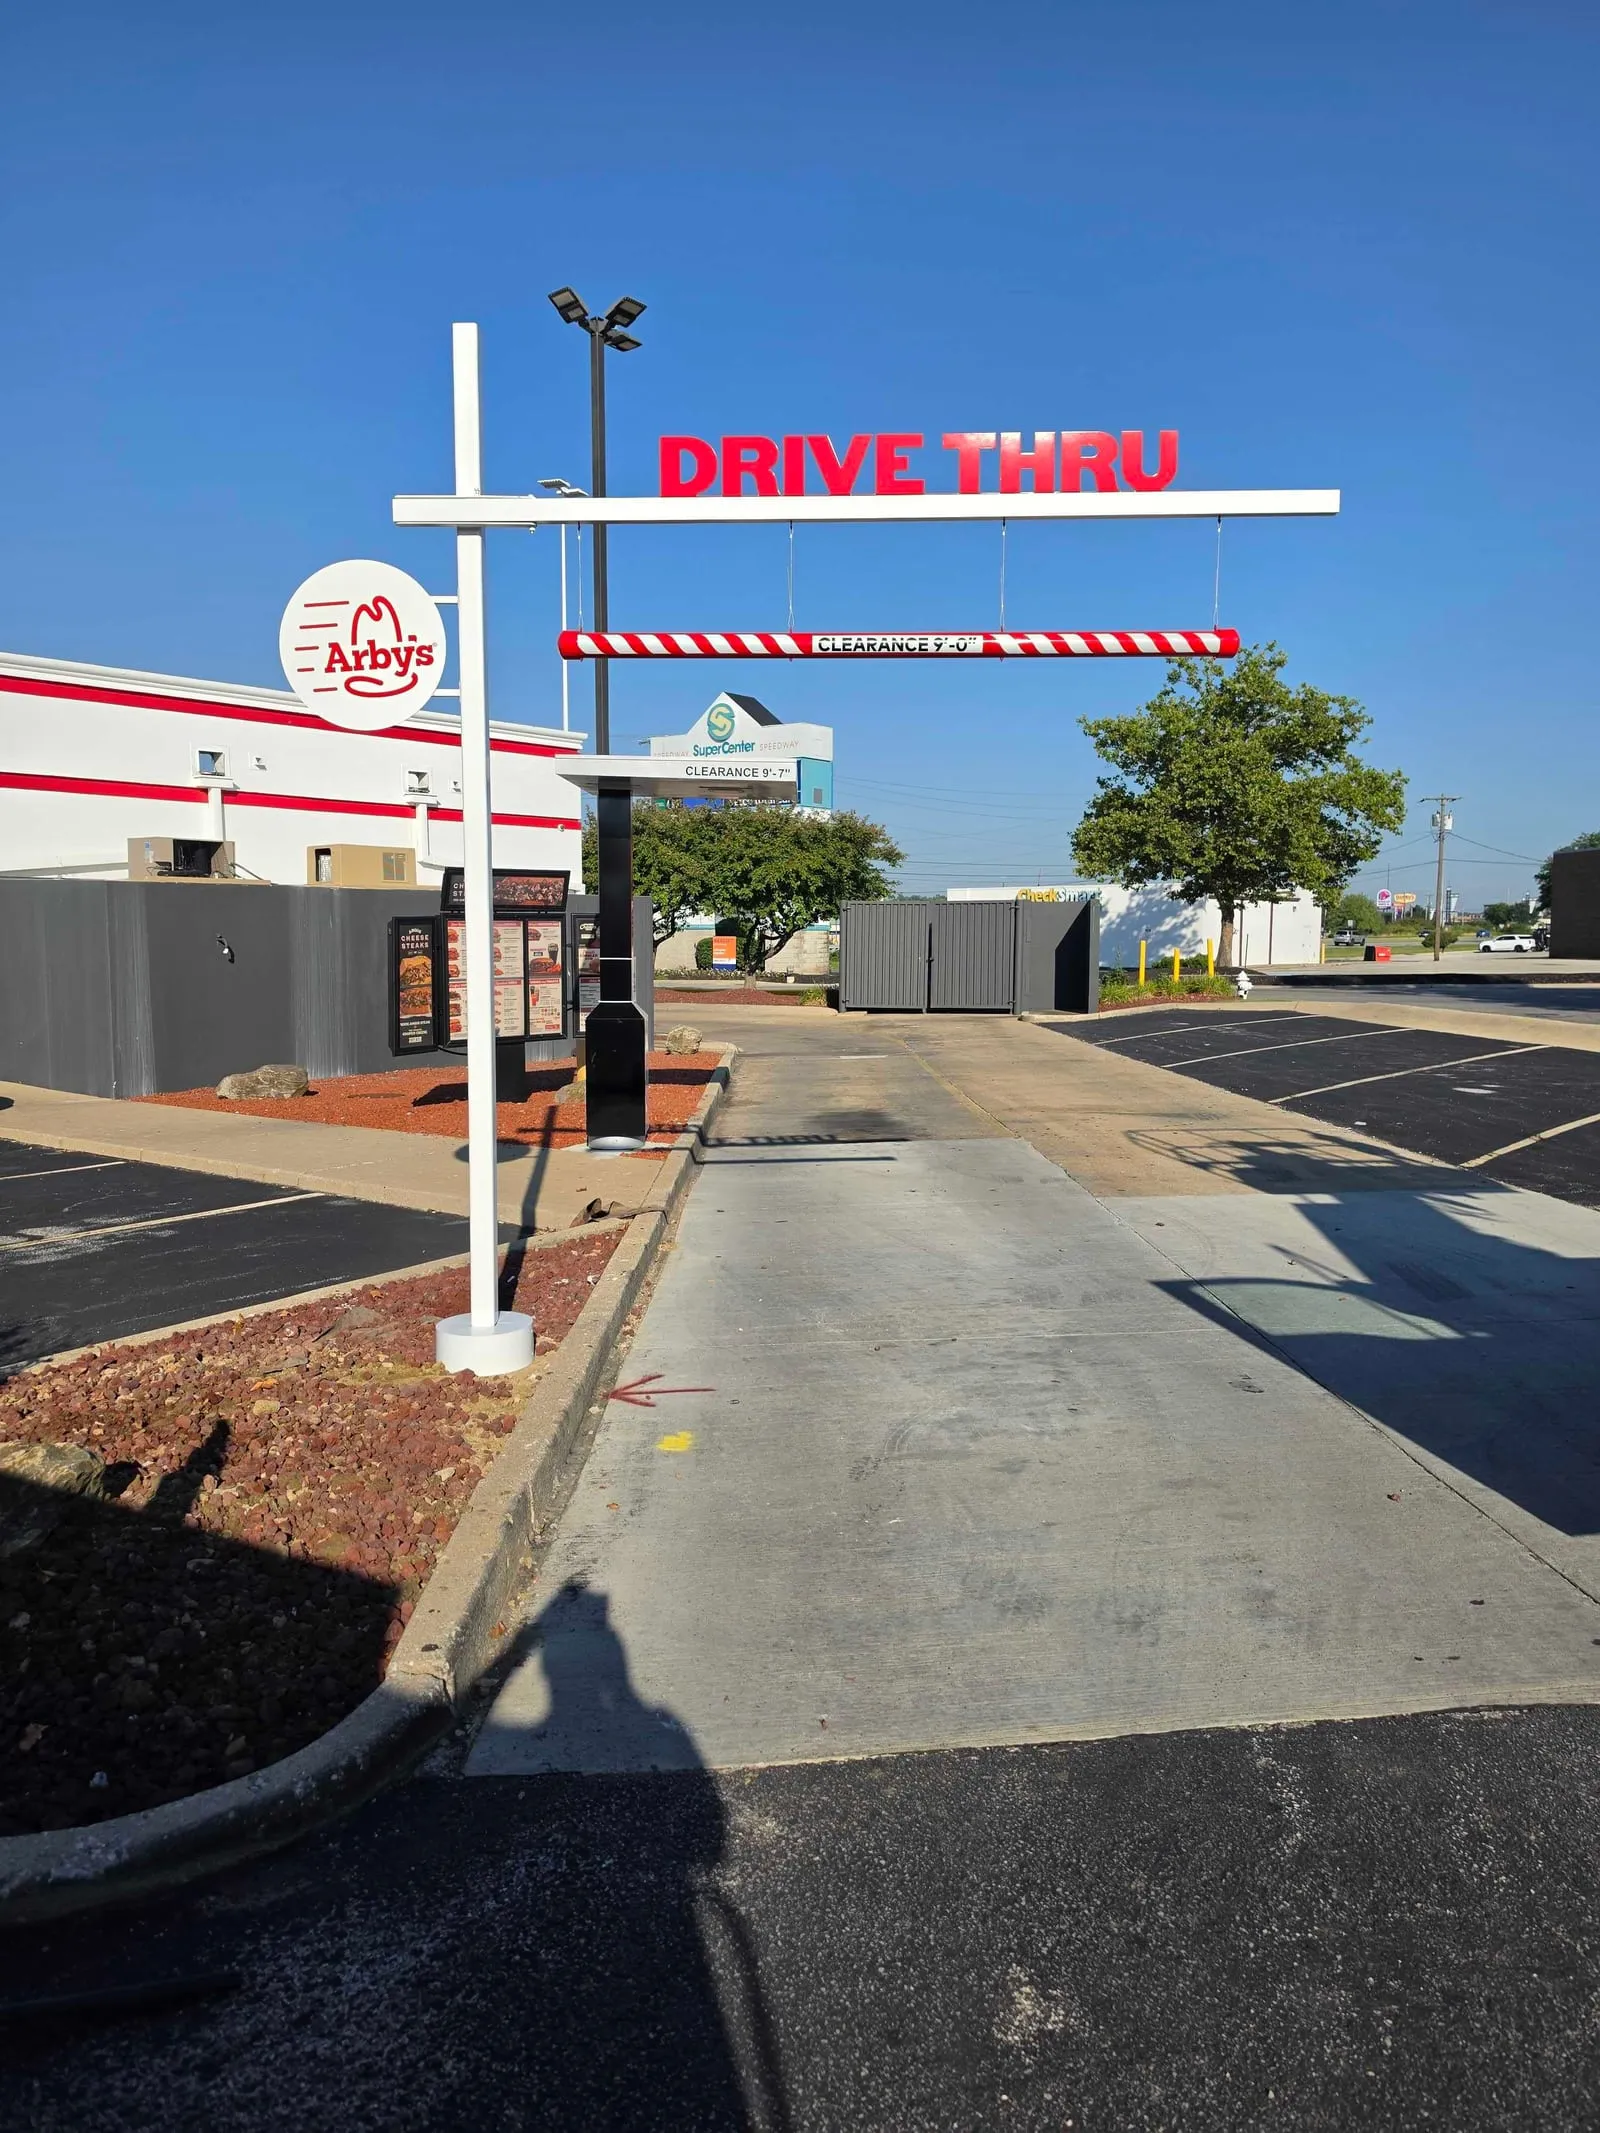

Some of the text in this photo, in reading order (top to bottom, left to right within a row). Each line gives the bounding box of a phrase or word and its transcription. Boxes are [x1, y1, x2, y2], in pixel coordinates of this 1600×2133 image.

[659, 430, 1178, 498] DRIVE THRU
[818, 637, 977, 652] CLEARANCE 9'-0"
[324, 635, 434, 677] Arby's
[693, 740, 755, 757] SuperCenter
[760, 740, 799, 751] SPEEDWAY
[685, 766, 791, 778] CLEARANCE 9'-7"
[400, 934, 430, 942] CHEESE
[401, 942, 430, 950] STEAKS
